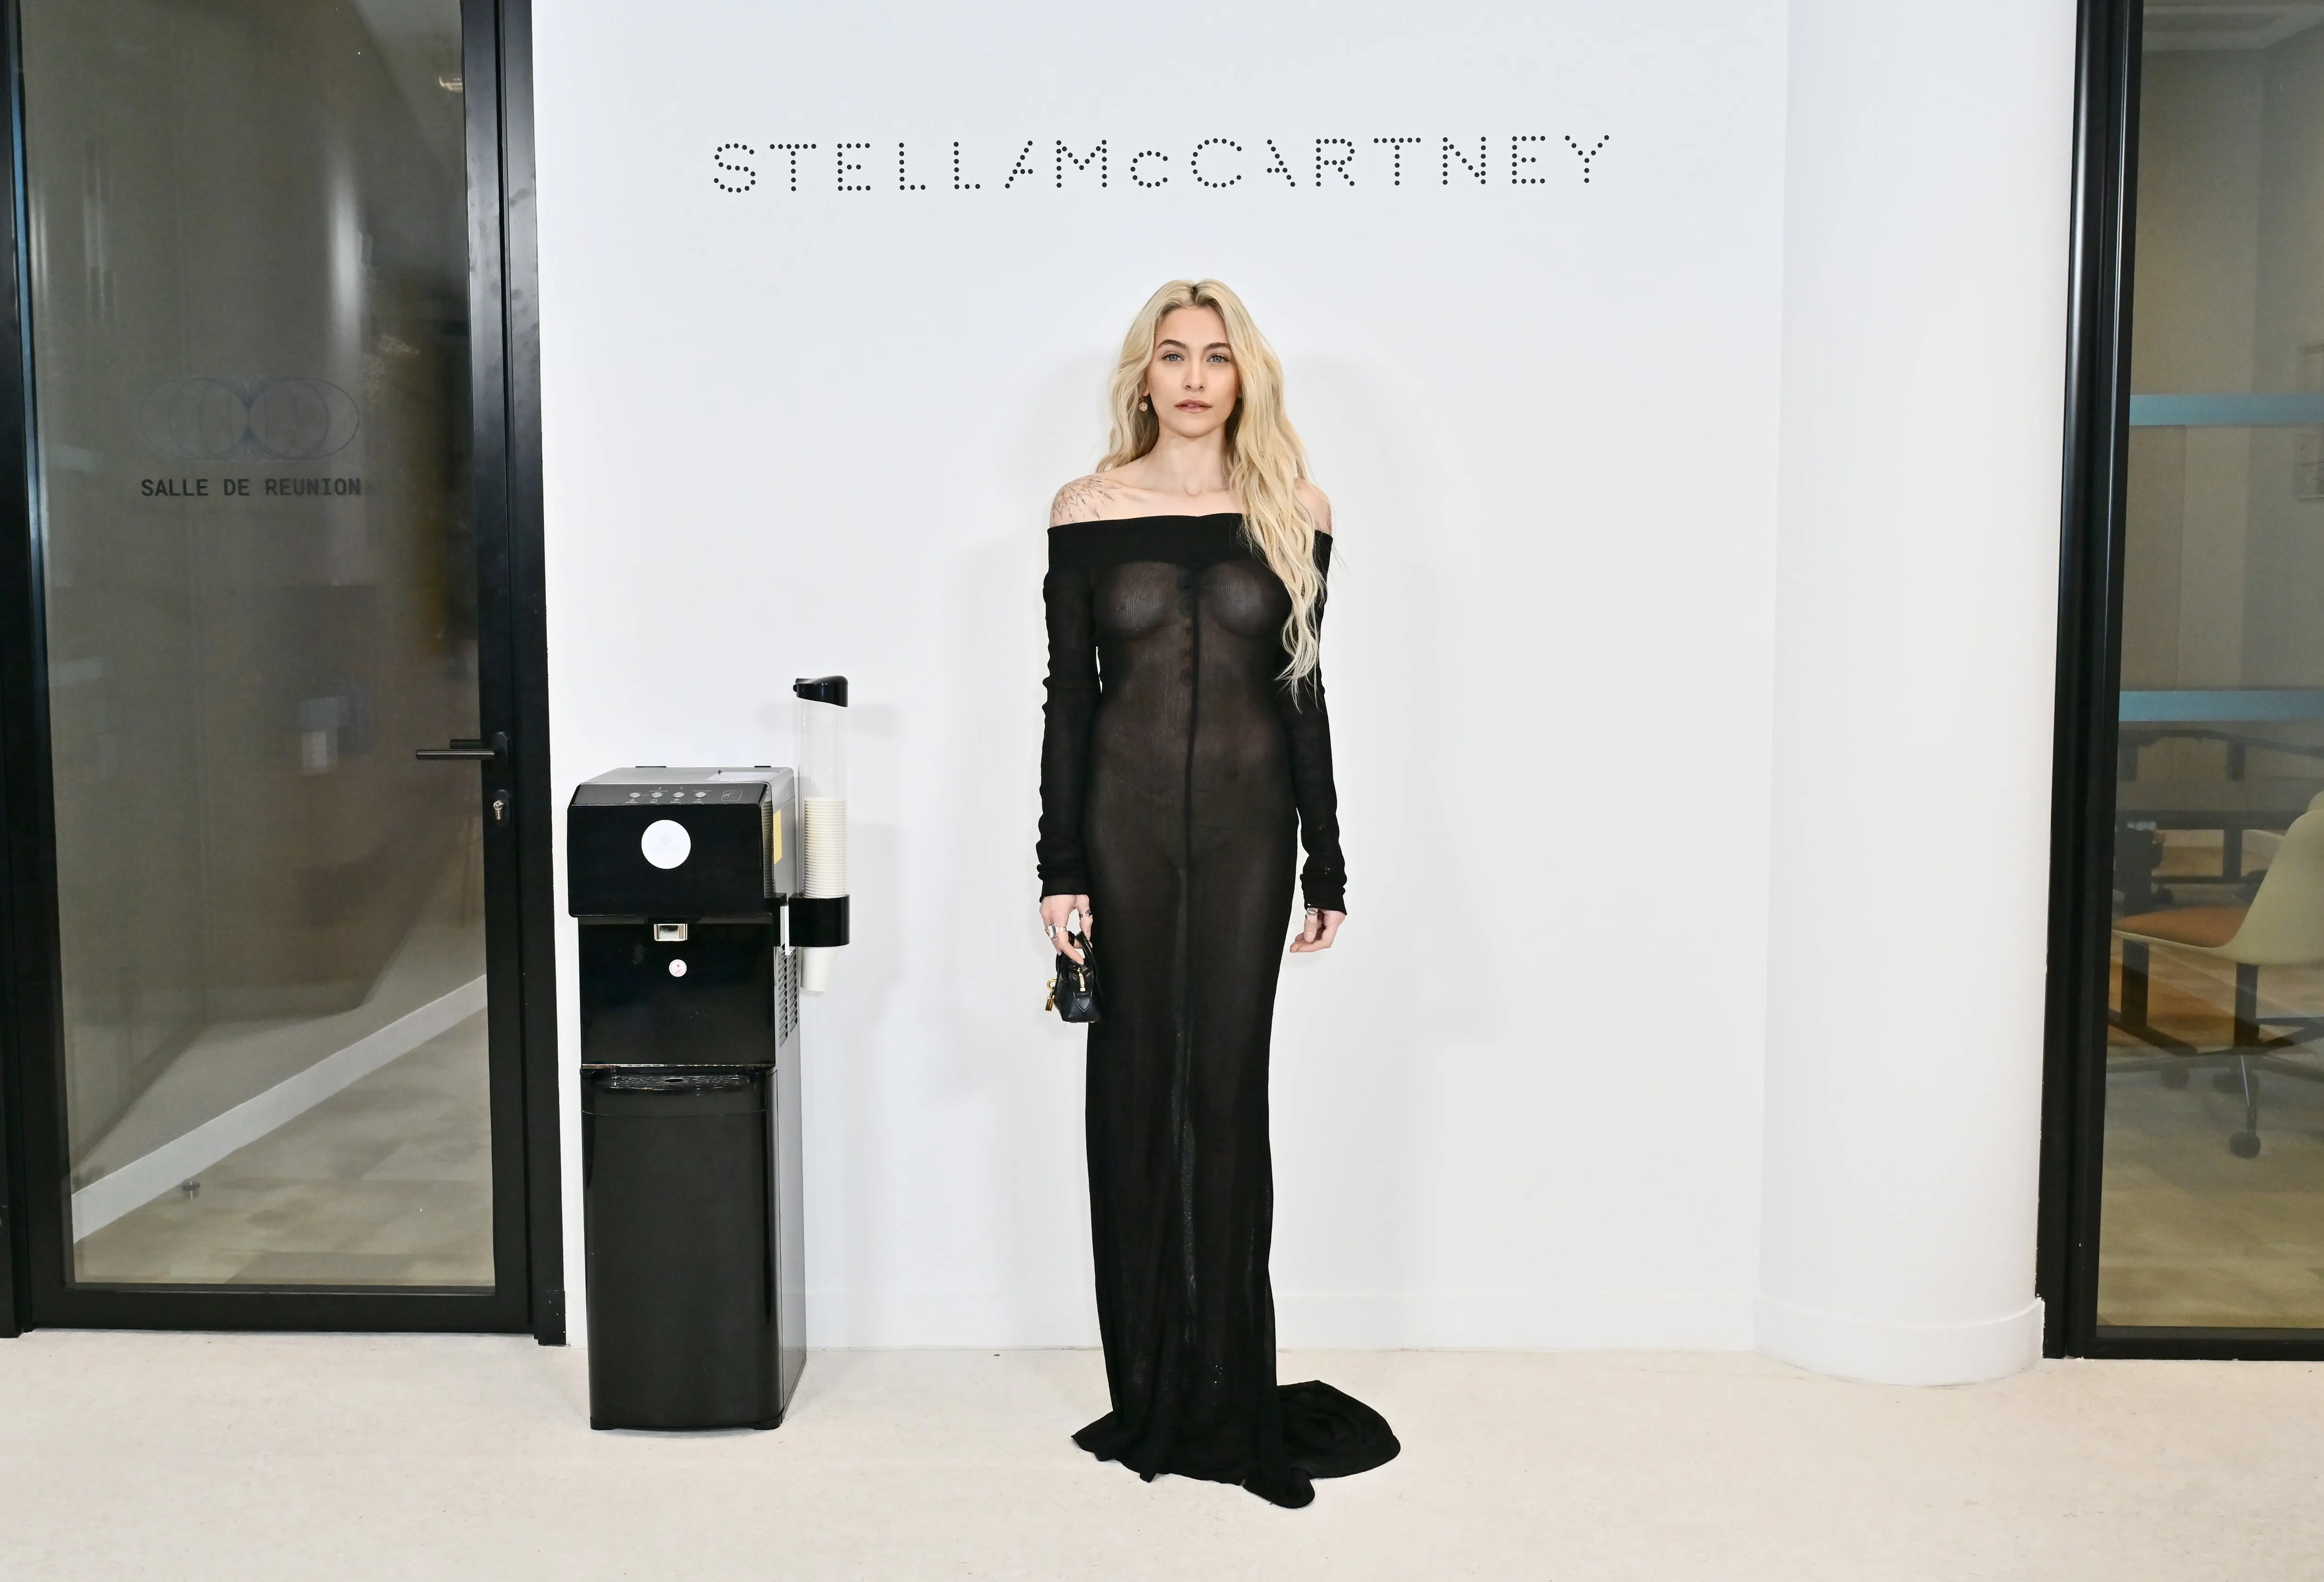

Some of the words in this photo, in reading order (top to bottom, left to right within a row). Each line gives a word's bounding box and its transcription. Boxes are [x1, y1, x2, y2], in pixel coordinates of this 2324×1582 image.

[141, 479, 208, 496] SALLE
[224, 478, 250, 496] DE
[265, 478, 361, 495] REUNION
